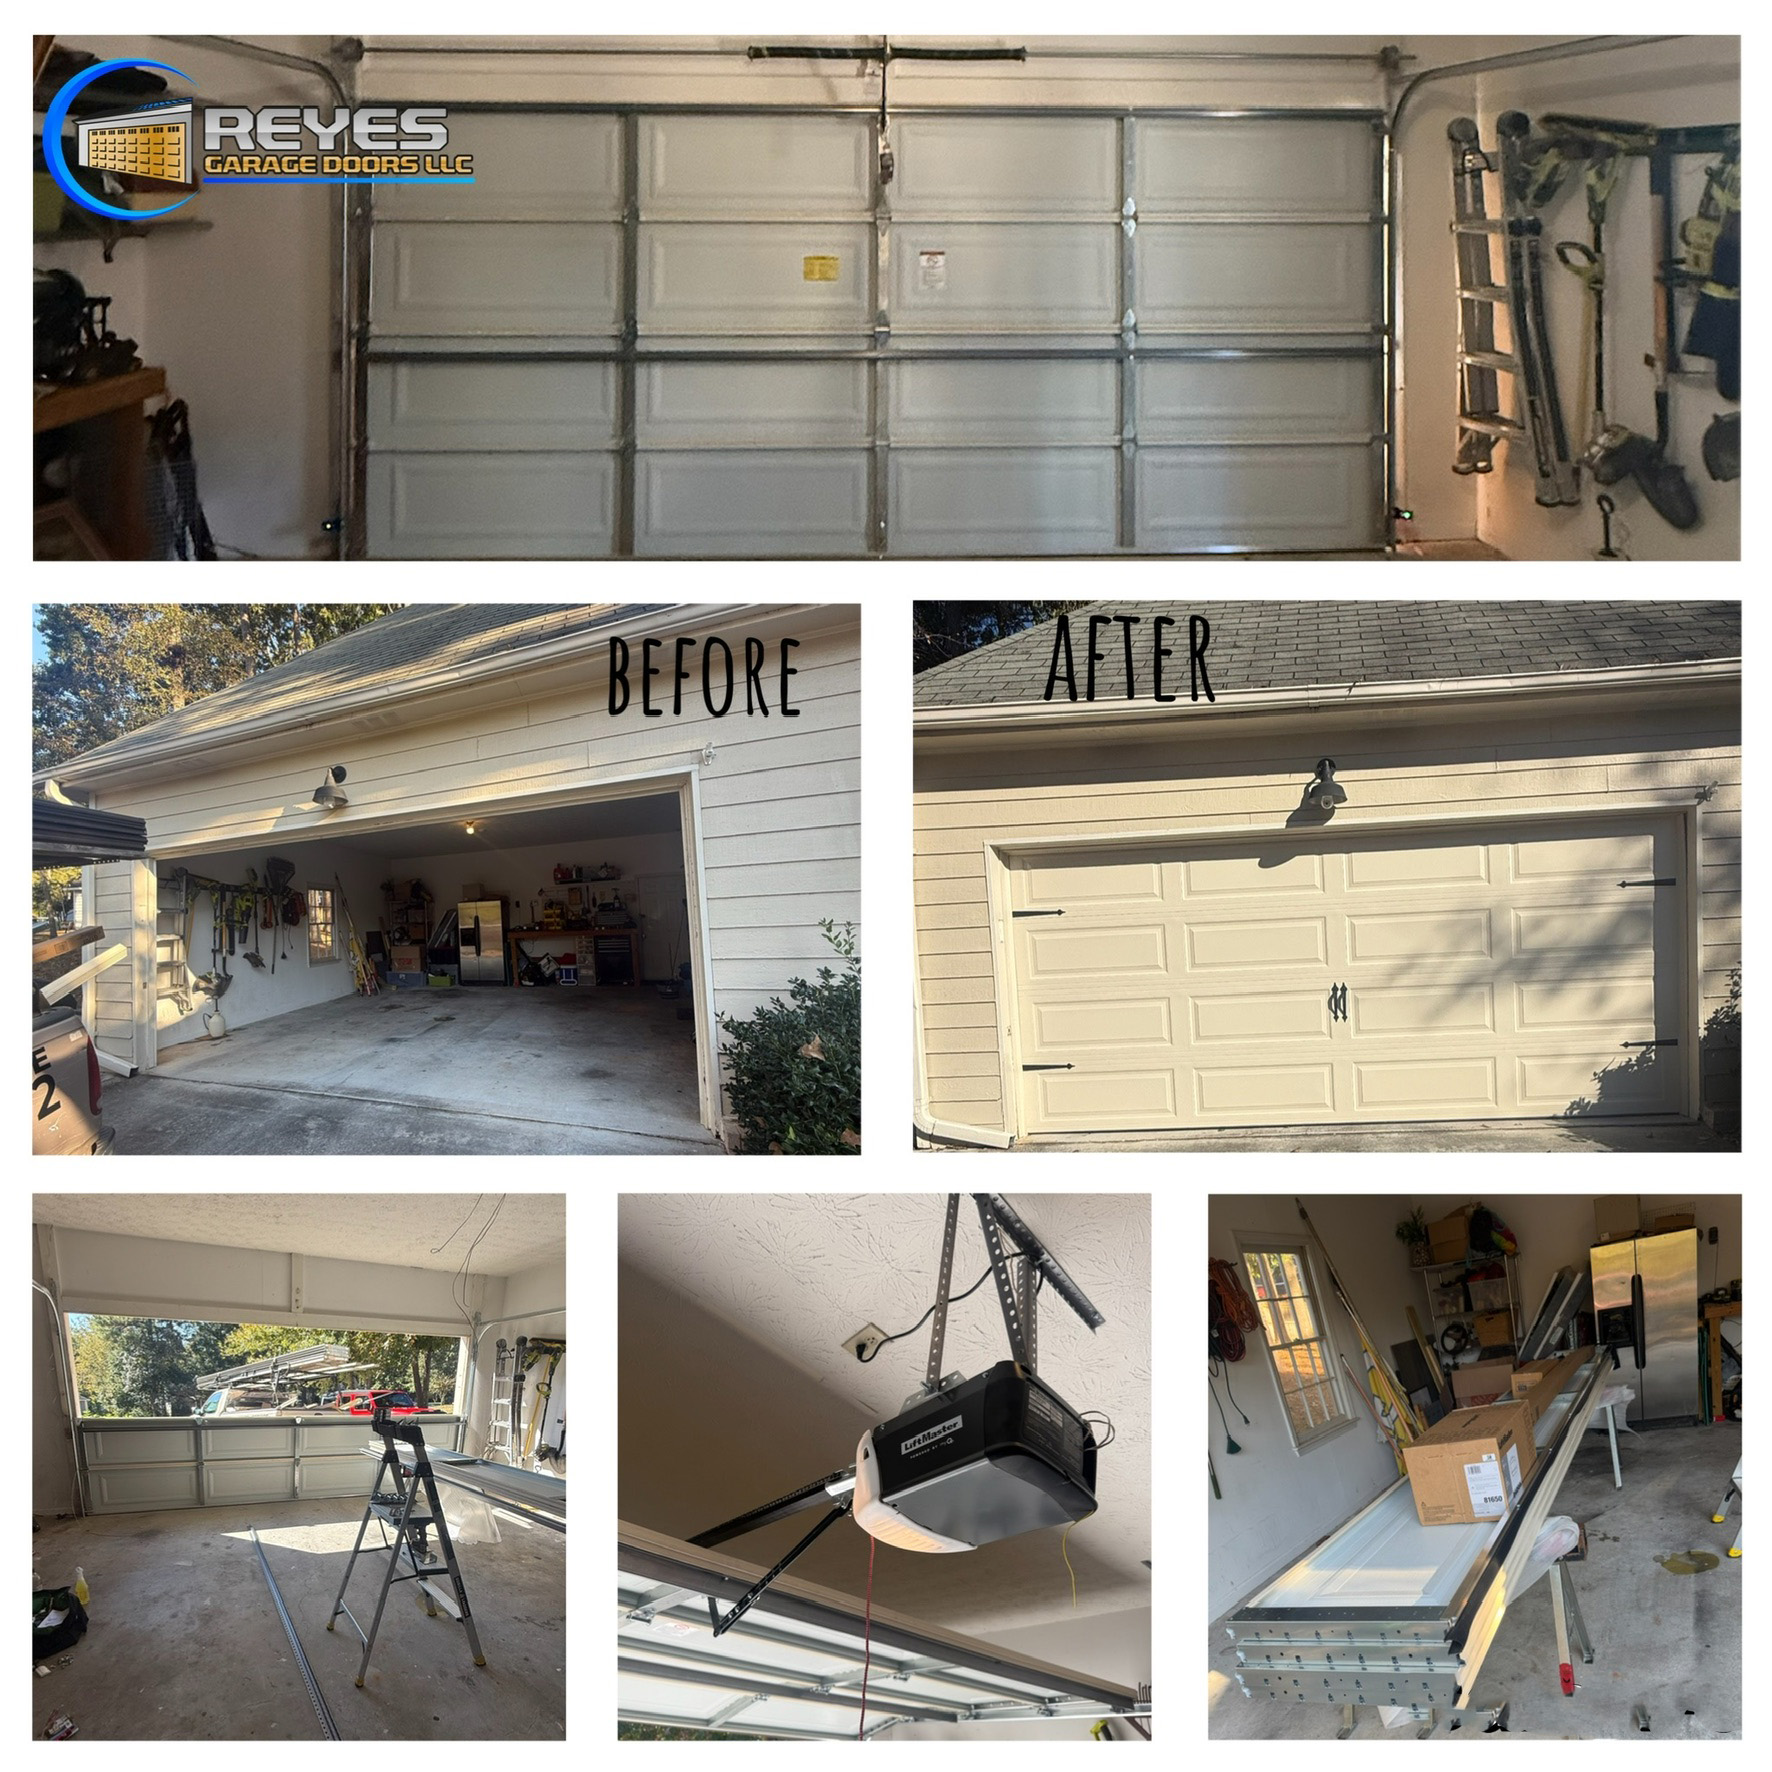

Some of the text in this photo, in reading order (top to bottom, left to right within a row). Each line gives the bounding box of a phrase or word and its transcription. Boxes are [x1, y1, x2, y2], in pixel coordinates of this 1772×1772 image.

[32, 1074, 61, 1121] 2
[904, 1421, 959, 1451] LiftMaster
[1483, 1495, 1503, 1504] 81650
